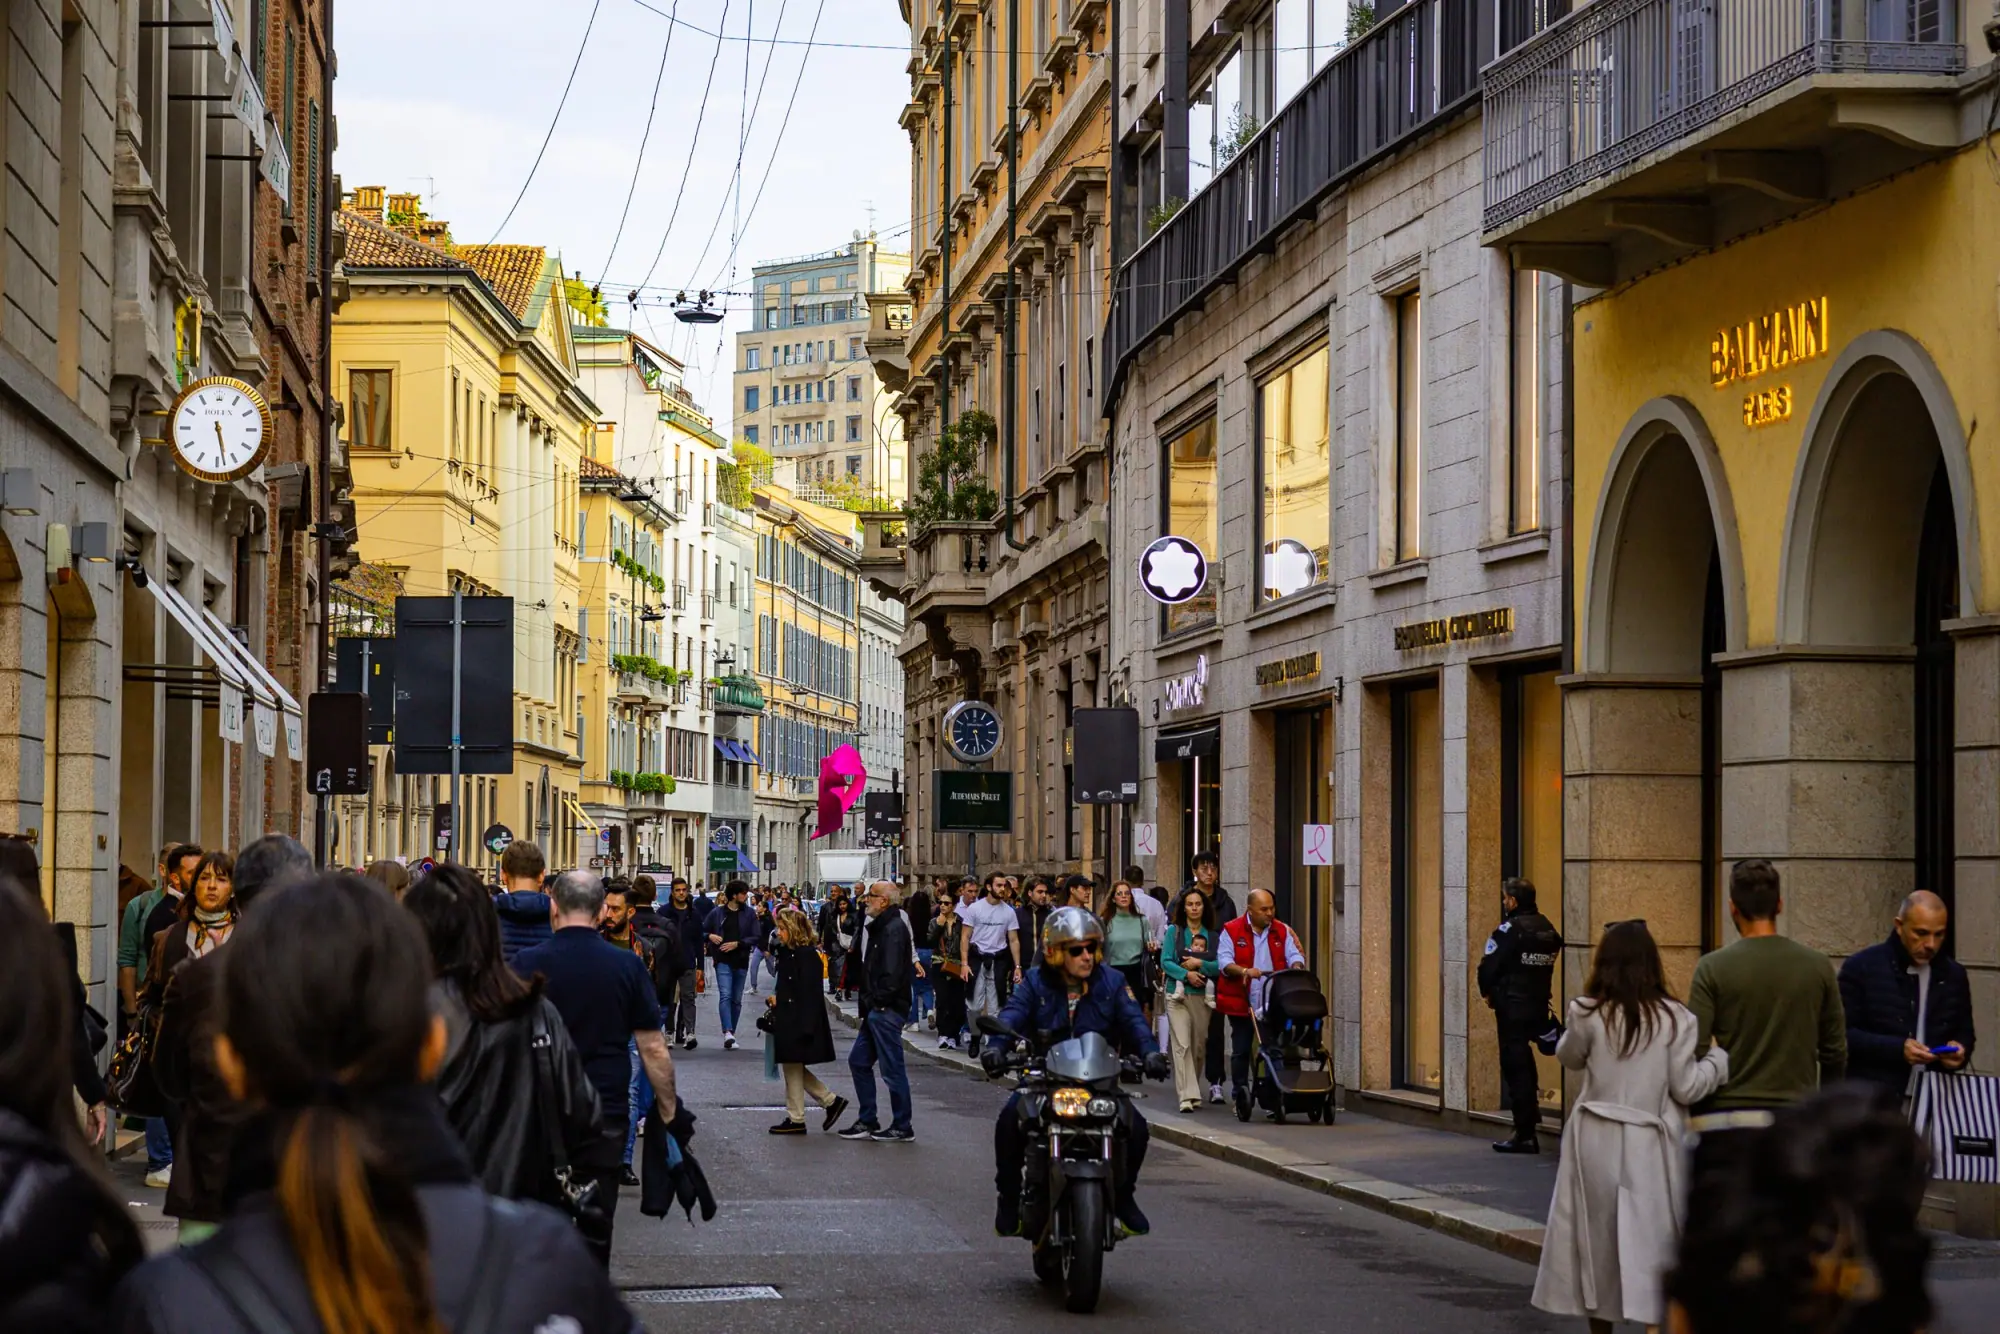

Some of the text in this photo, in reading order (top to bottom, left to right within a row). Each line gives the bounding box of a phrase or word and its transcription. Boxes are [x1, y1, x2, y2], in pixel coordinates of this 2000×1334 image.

[1710, 297, 1827, 386] BALMAIN
[1743, 386, 1792, 426] PARIS
[949, 791, 1001, 801] AUDEMARS PIGUET
